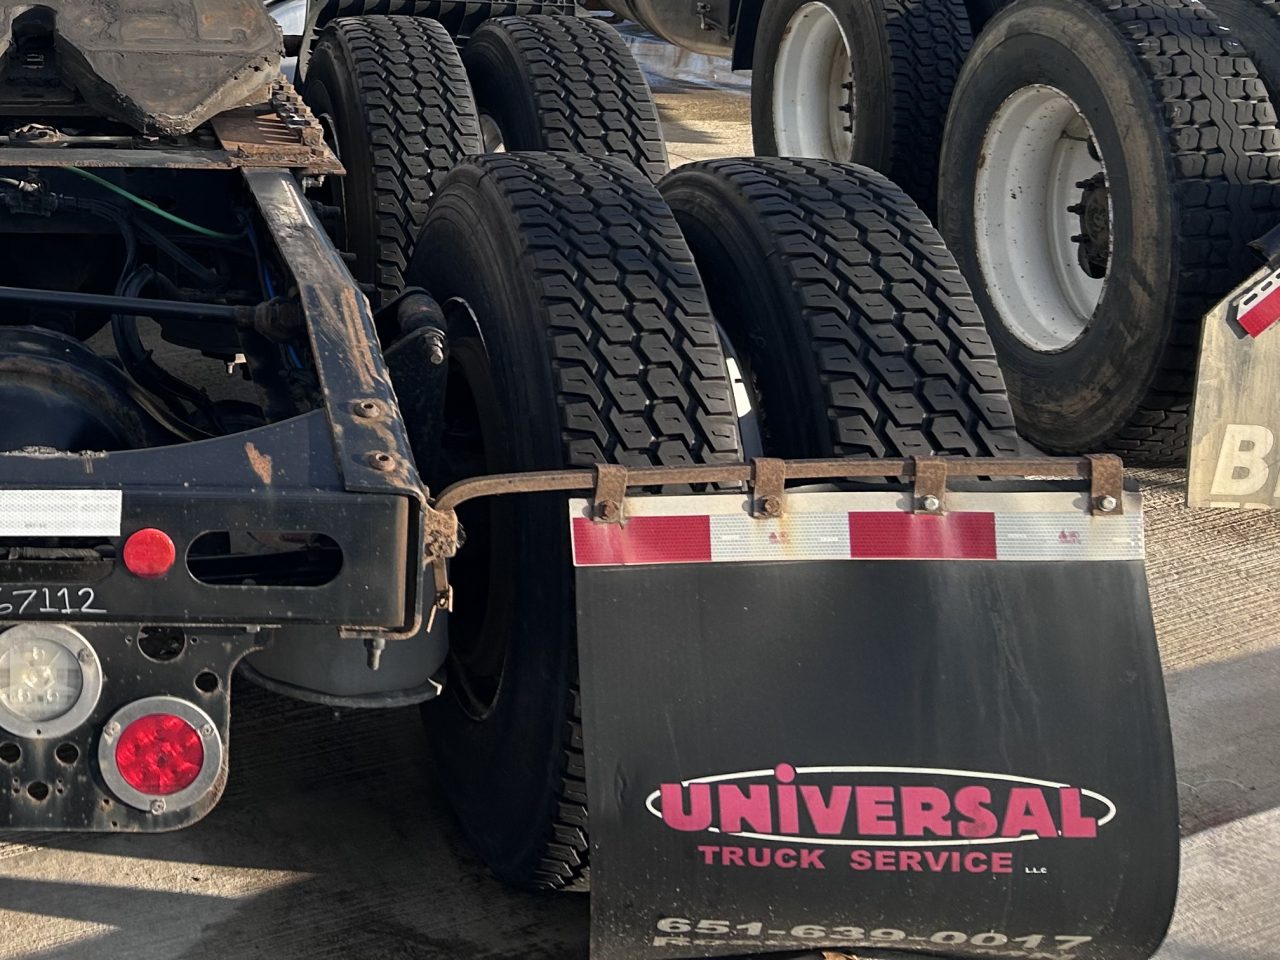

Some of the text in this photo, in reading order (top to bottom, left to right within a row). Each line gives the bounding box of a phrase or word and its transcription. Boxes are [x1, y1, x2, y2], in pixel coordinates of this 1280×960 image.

[1210, 424, 1280, 497] B
[697, 845, 825, 871] TRUCK
[850, 849, 1014, 874] SERVICE
[656, 917, 1093, 950] 651-639-0017
